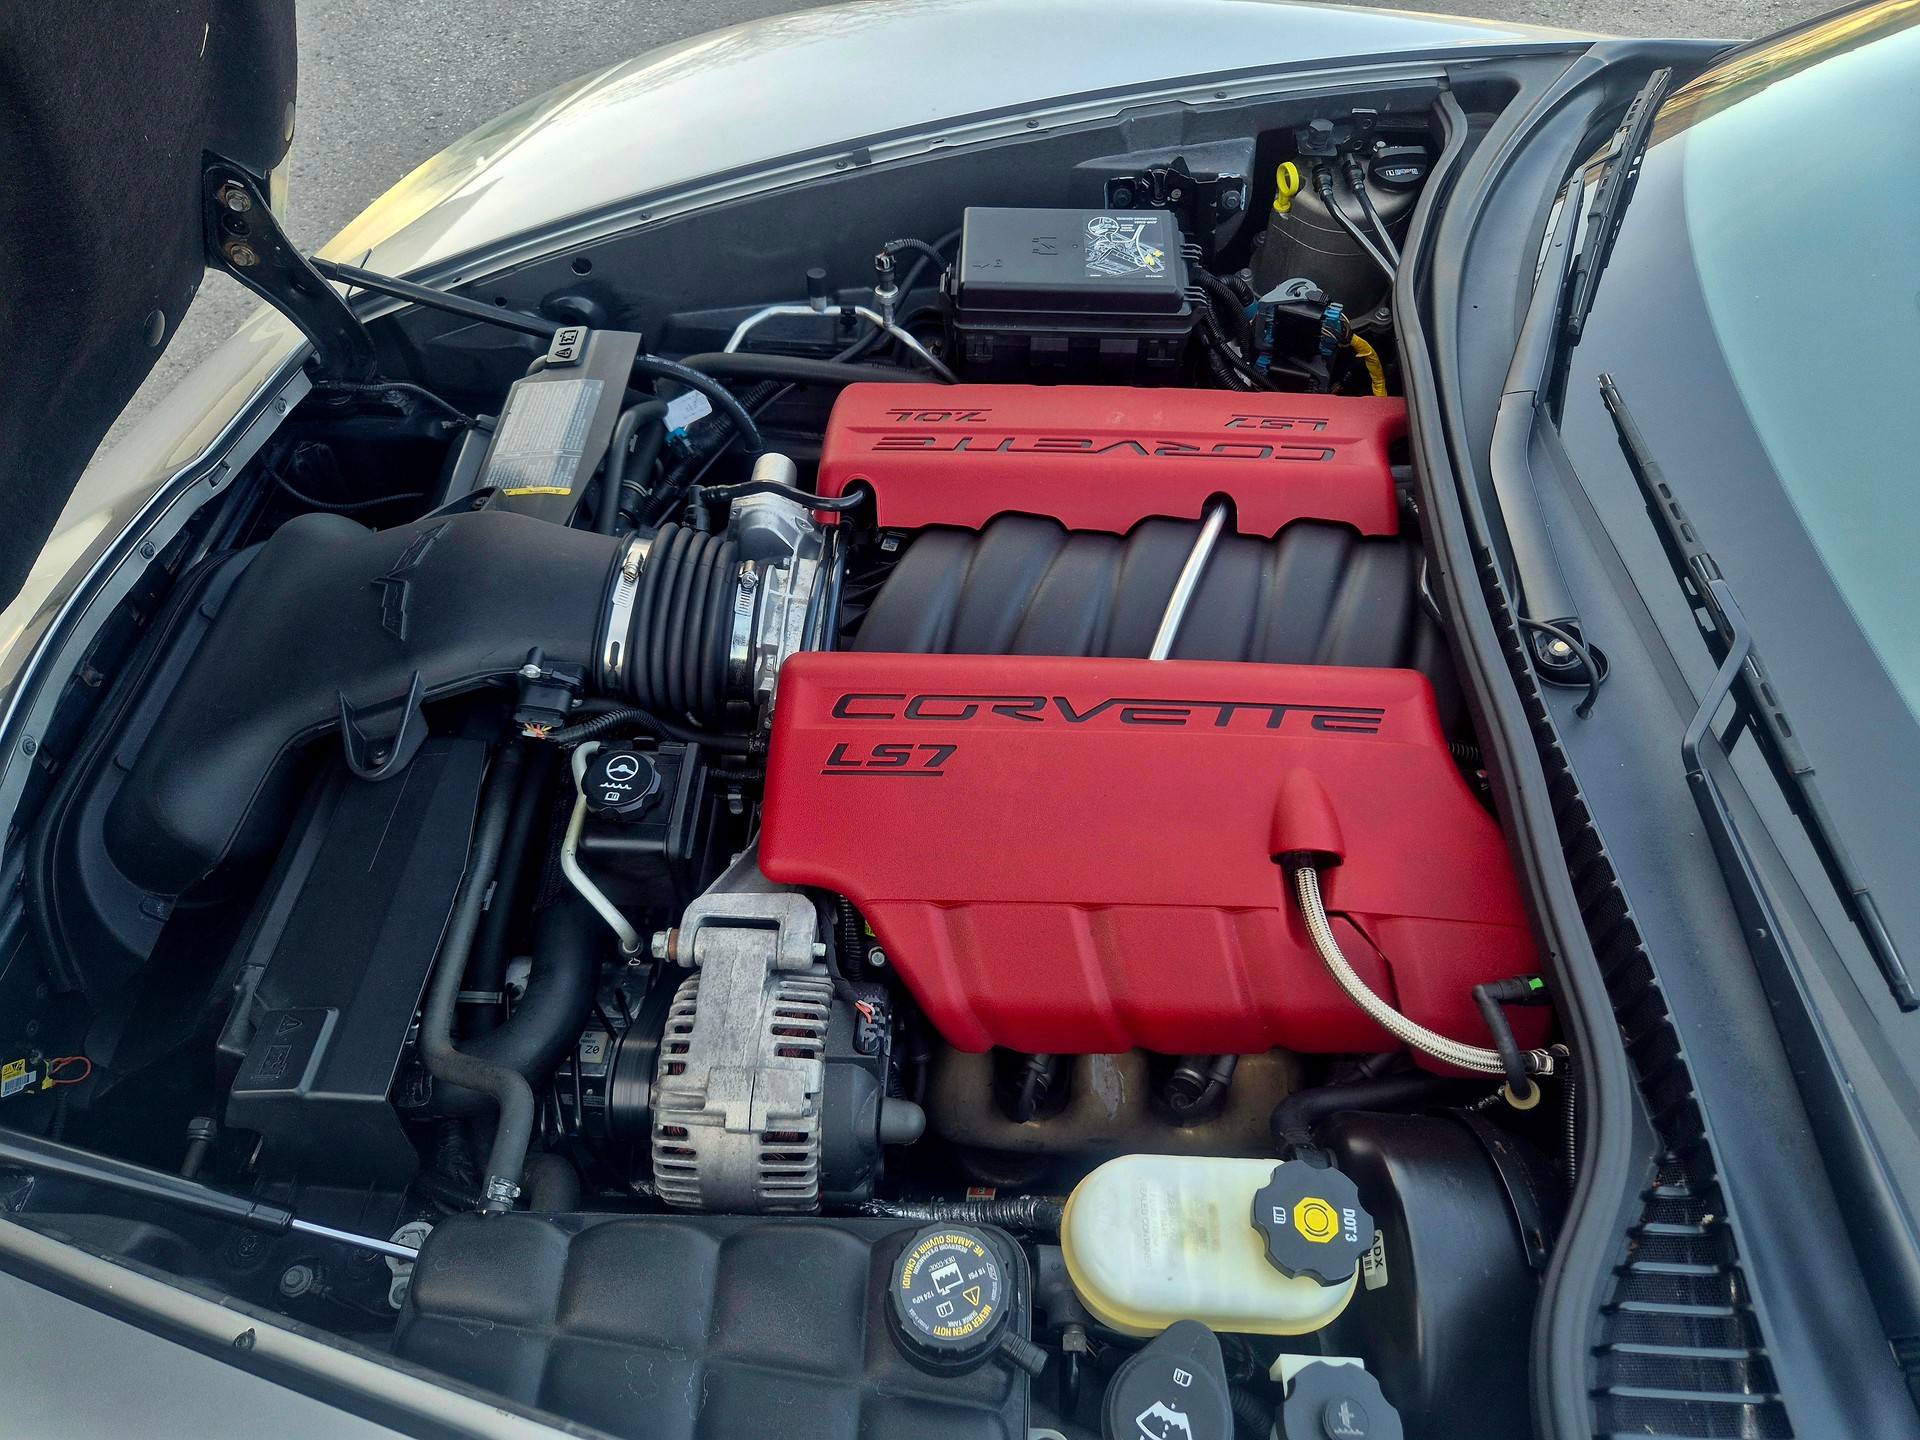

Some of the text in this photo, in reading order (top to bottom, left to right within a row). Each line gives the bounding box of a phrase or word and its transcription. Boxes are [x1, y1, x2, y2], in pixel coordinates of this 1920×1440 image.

[890, 410, 988, 422] 7.0L
[1223, 417, 1330, 431] LS7
[870, 436, 1337, 462] CORVETTE
[831, 693, 1386, 734] CORVETTE
[825, 743, 958, 768] LS7
[1140, 1182, 1152, 1268] SEALED CONTAINER
[1343, 1207, 1358, 1243] DOT 3
[918, 1236, 944, 1253] OUVRIR
[946, 1235, 975, 1250] JAMAIS
[972, 1244, 985, 1257] NE
[902, 1259, 916, 1289] CHAUD!
[968, 1271, 978, 1280] PSI
[978, 1267, 986, 1276] 18
[911, 1290, 935, 1304] 124 kPa
[933, 1304, 993, 1337] NEVER OPEN HOT!
